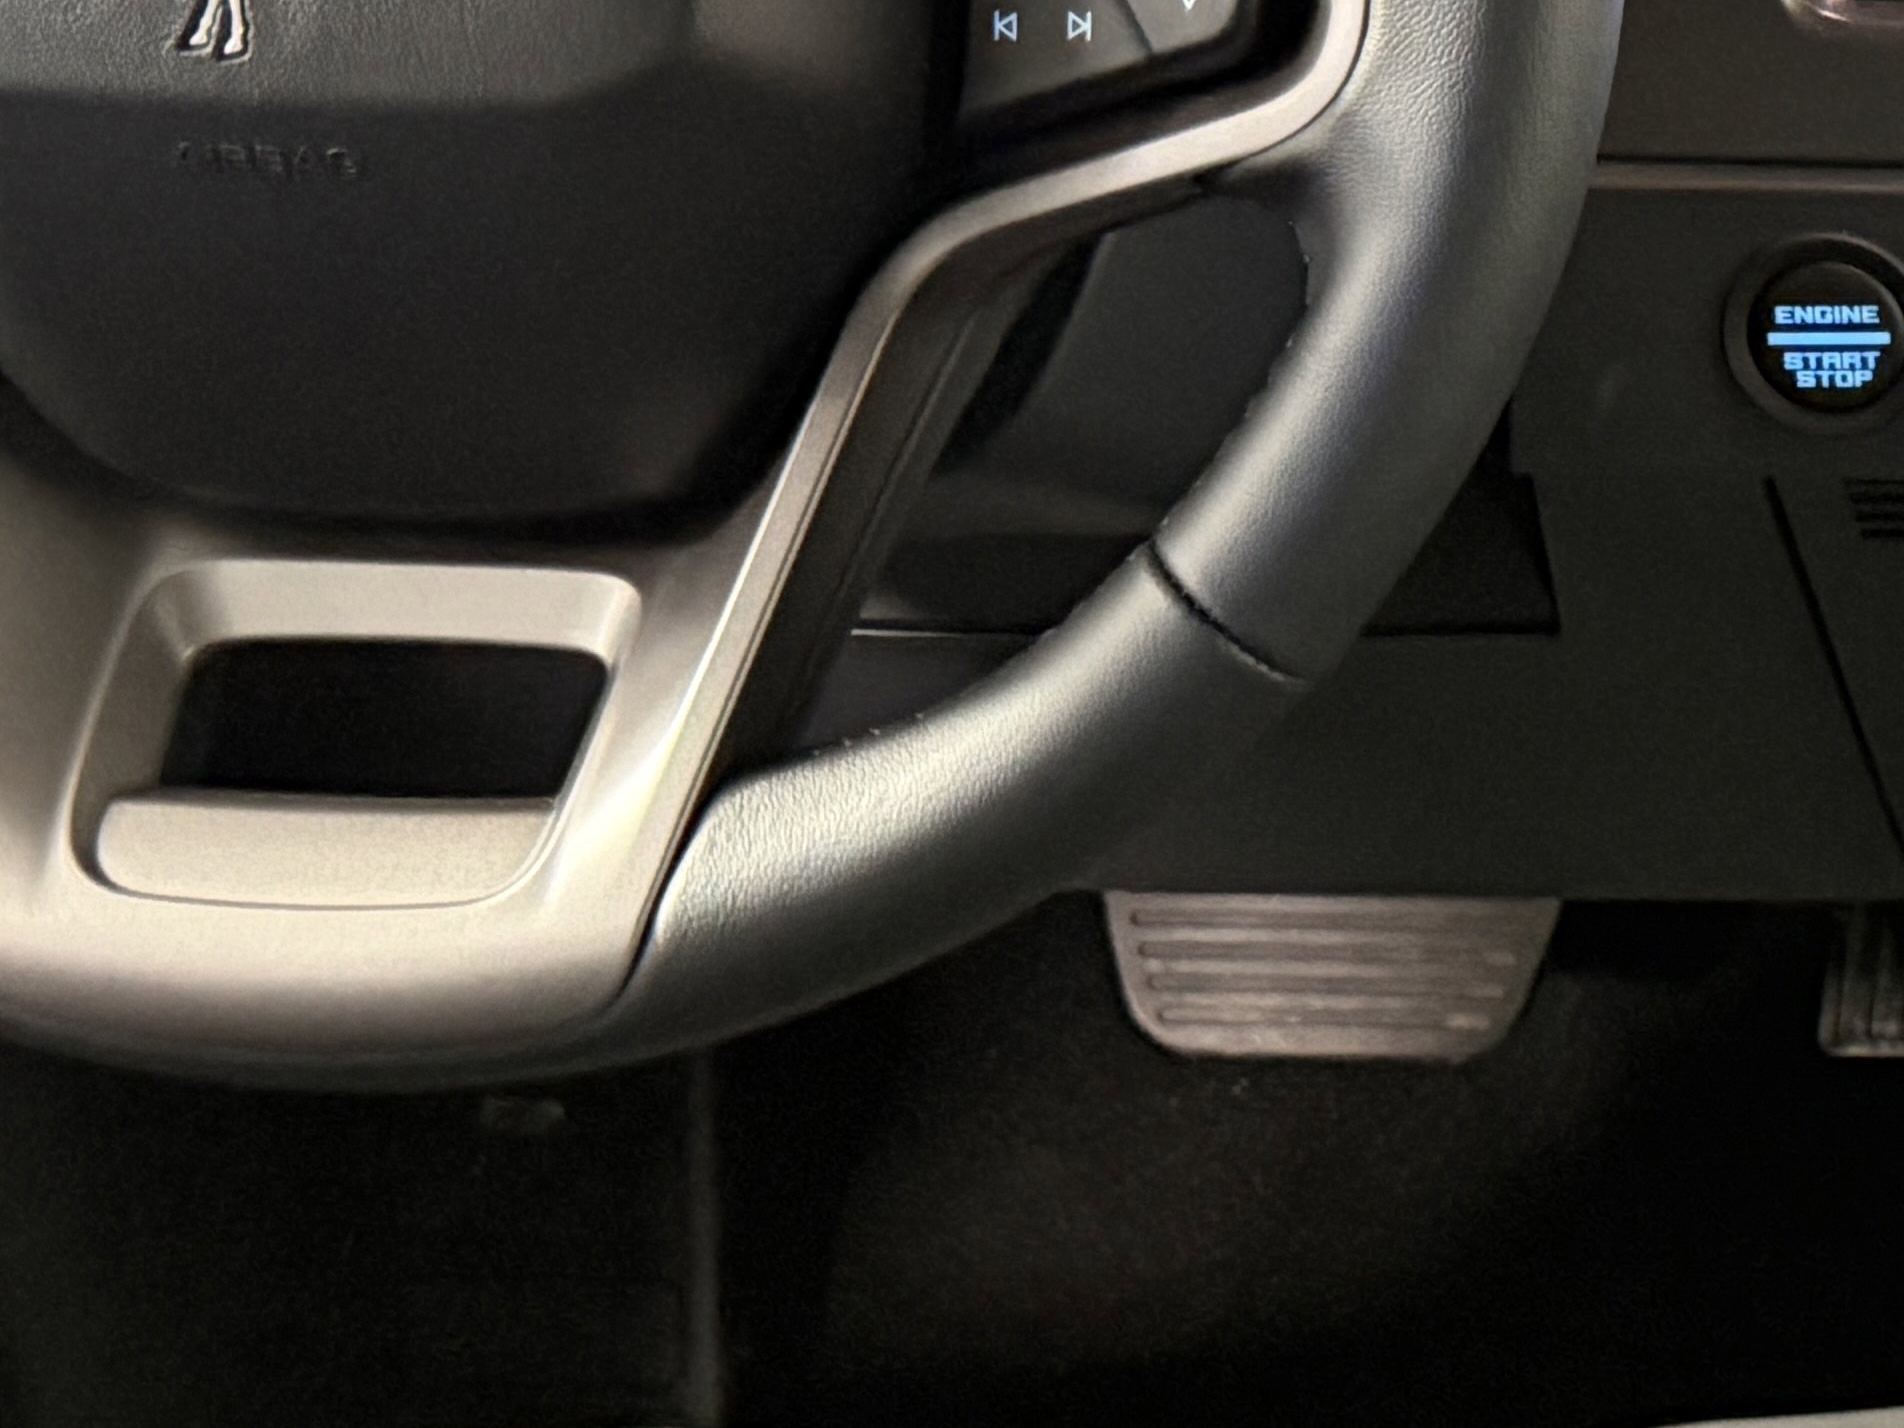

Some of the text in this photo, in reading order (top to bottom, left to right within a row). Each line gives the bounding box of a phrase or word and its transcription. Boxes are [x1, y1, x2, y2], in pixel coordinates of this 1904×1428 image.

[1774, 305, 1880, 325] ENGINE
[1783, 351, 1881, 370] START
[1796, 371, 1873, 388] STOP
